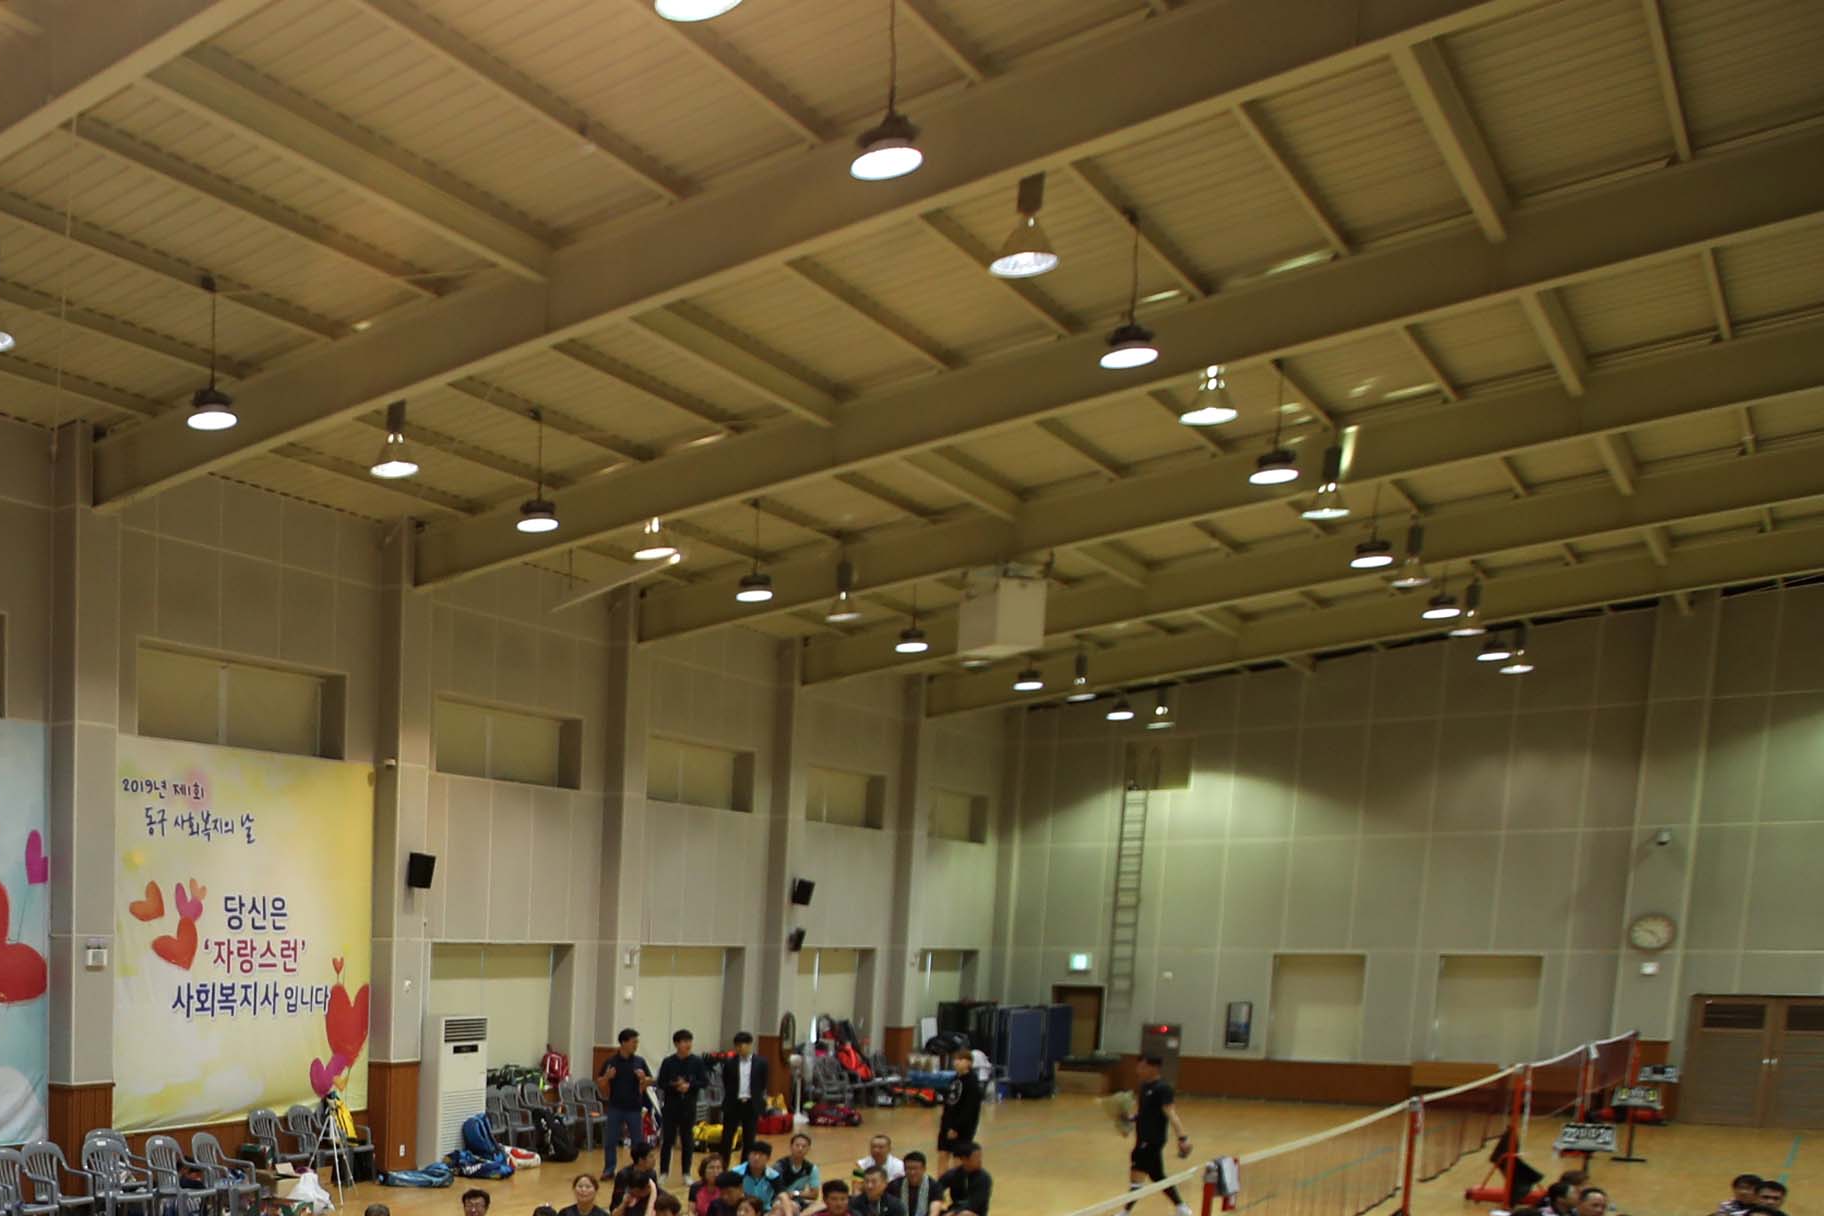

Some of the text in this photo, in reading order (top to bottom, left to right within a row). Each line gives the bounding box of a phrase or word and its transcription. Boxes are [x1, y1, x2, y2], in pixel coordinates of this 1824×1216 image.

[121, 778, 205, 800] 2019년 제1회
[144, 807, 256, 844] 동구 사회복지의 날
[223, 894, 288, 931] 당신은
[171, 981, 330, 1019] 사회복지사 입니다
